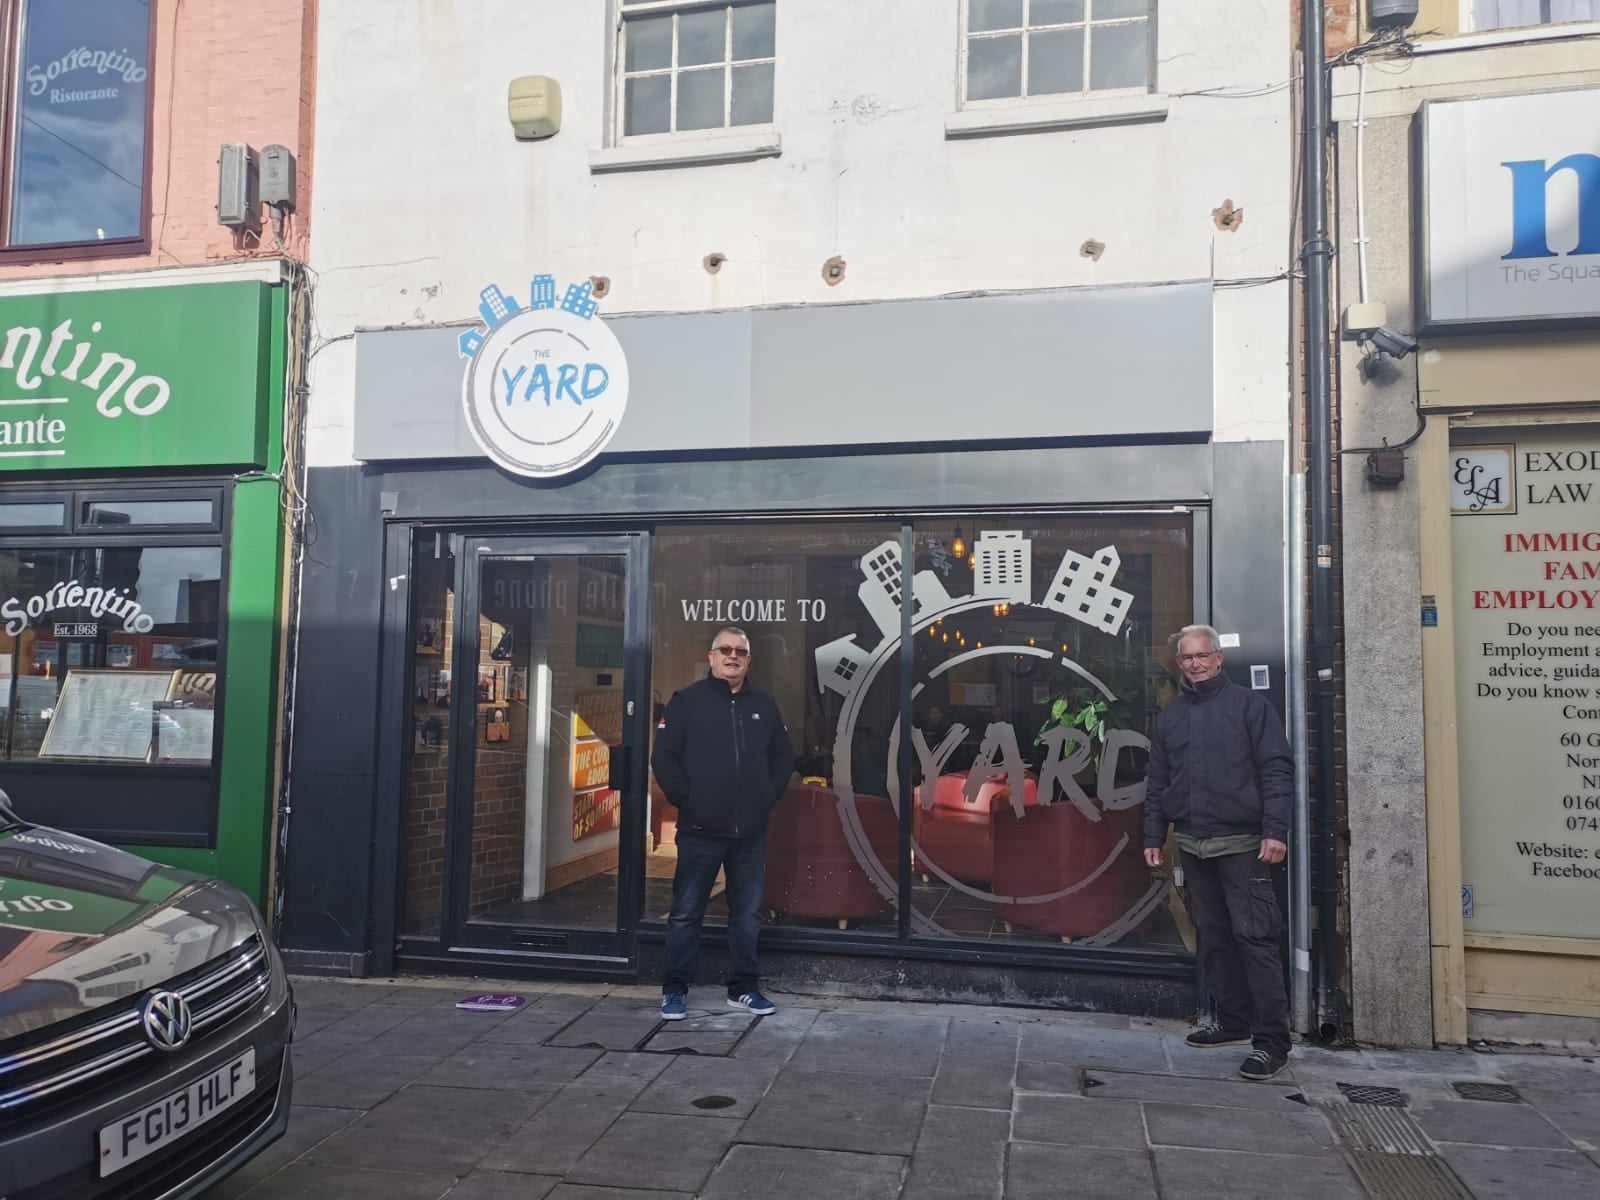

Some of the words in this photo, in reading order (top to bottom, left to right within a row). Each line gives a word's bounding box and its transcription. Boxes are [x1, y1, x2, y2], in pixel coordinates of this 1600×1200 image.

[26, 46, 147, 96] Sorrentino
[50, 87, 119, 104] Ristorante
[1500, 263, 1541, 283] The
[1548, 262, 1600, 283] Squa
[533, 349, 551, 359] THE
[502, 363, 609, 406] YARD
[1526, 483, 1593, 504] LAW
[1504, 532, 1600, 552] IMMIG
[1, 579, 154, 636] Sorrentino
[1472, 590, 1600, 609] EMPLOY
[681, 599, 787, 622] WELCOME
[797, 598, 826, 622] TO
[54, 623, 70, 635] Est.
[73, 623, 98, 635] 1968
[1507, 622, 1532, 636] Do
[1537, 626, 1568, 640] you
[1481, 642, 1590, 660] Employment
[1488, 663, 1548, 679] advice,
[1553, 664, 1600, 681] guida
[1477, 683, 1502, 697] Do
[1507, 687, 1537, 701] you
[1543, 684, 1590, 698] know
[1560, 732, 1581, 747] 60
[1516, 842, 1588, 859] Website:
[121, 1093, 190, 1158] FG13
[199, 1061, 243, 1117] HLF
